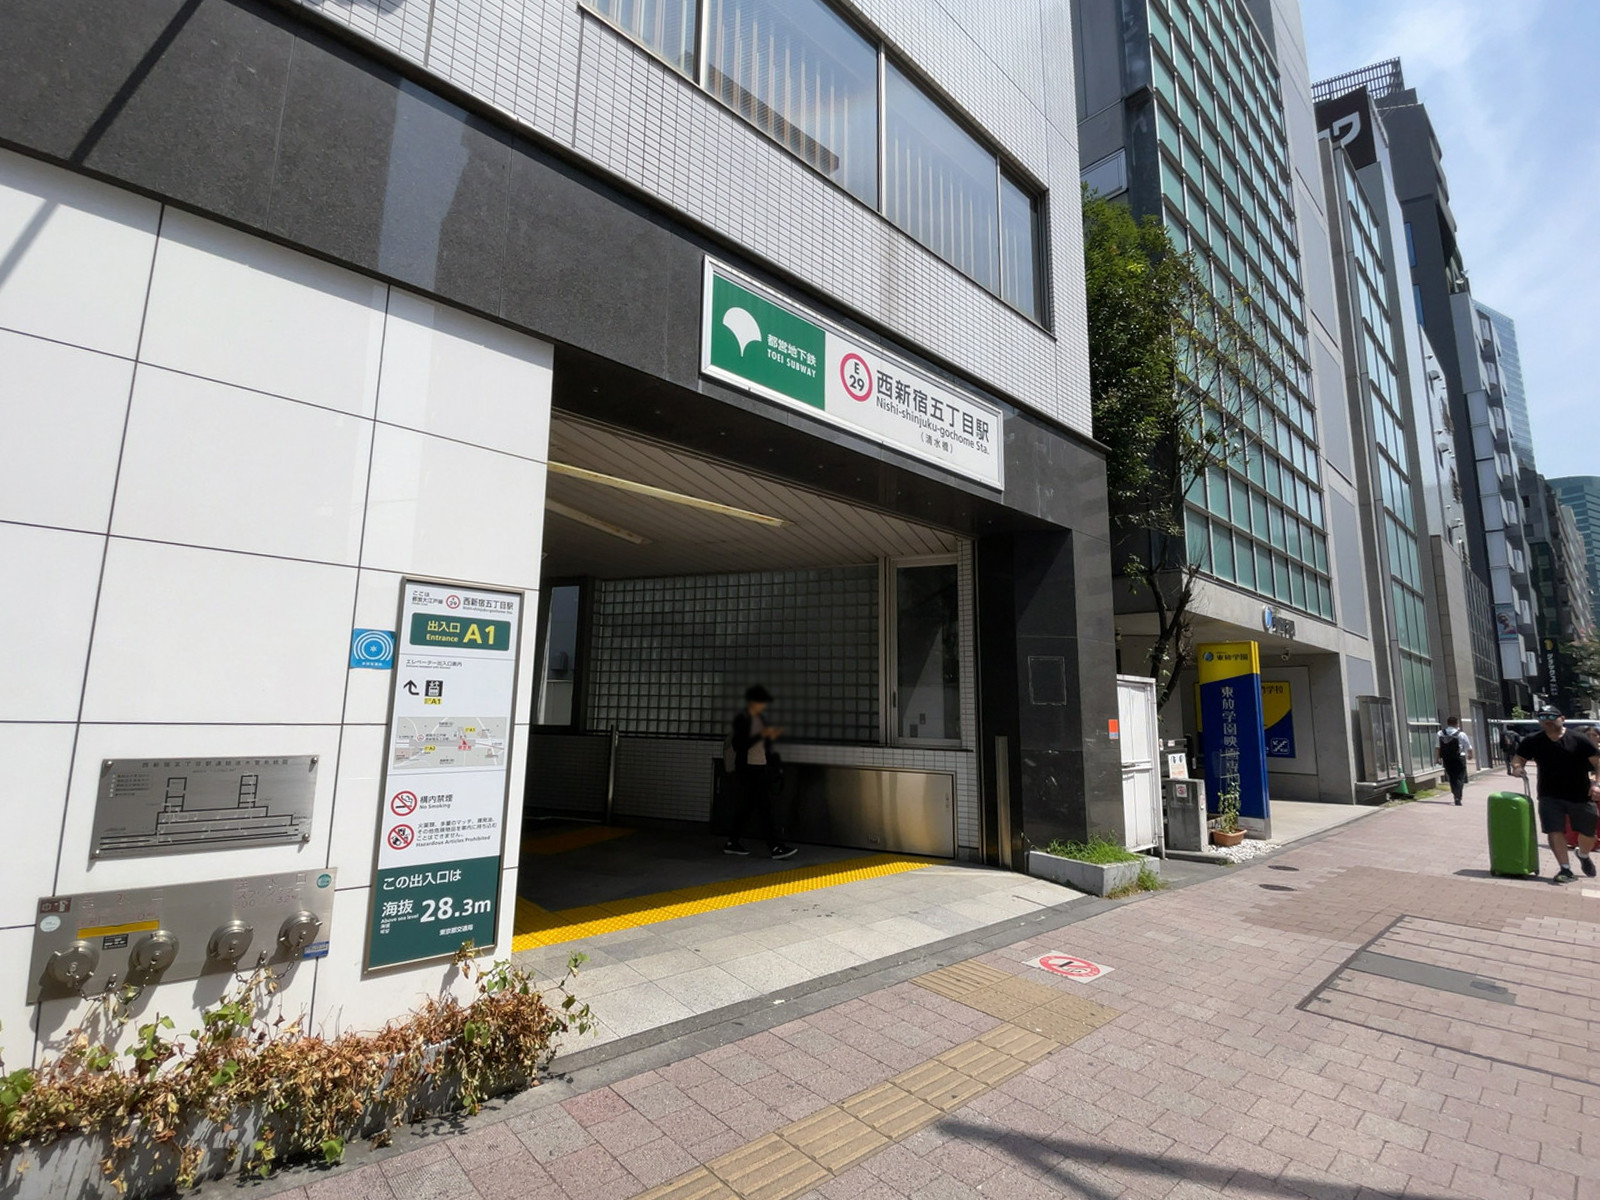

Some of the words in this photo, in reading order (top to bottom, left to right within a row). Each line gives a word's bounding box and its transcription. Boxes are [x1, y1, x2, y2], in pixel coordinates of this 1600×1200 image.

[767, 334, 817, 367] 都営地下鉄
[767, 349, 784, 364] TOEI
[786, 358, 817, 378] SUBWAY
[853, 361, 861, 376] E
[848, 375, 865, 392] 29
[876, 369, 990, 443] 西新宿五丁目駅
[876, 395, 975, 449] Nishi-shinjuku-gochome
[975, 440, 991, 455] Sta.
[463, 597, 514, 611] 西新宿五丁目駅
[427, 620, 460, 633] 出入口
[462, 623, 495, 646] A1
[426, 633, 459, 643] Entrance
[420, 794, 453, 804] 構内禁煙
[416, 840, 444, 848] Hazardous
[382, 868, 462, 891] この出入口は
[381, 898, 414, 918] 海抜
[420, 896, 492, 923] 28.3m
